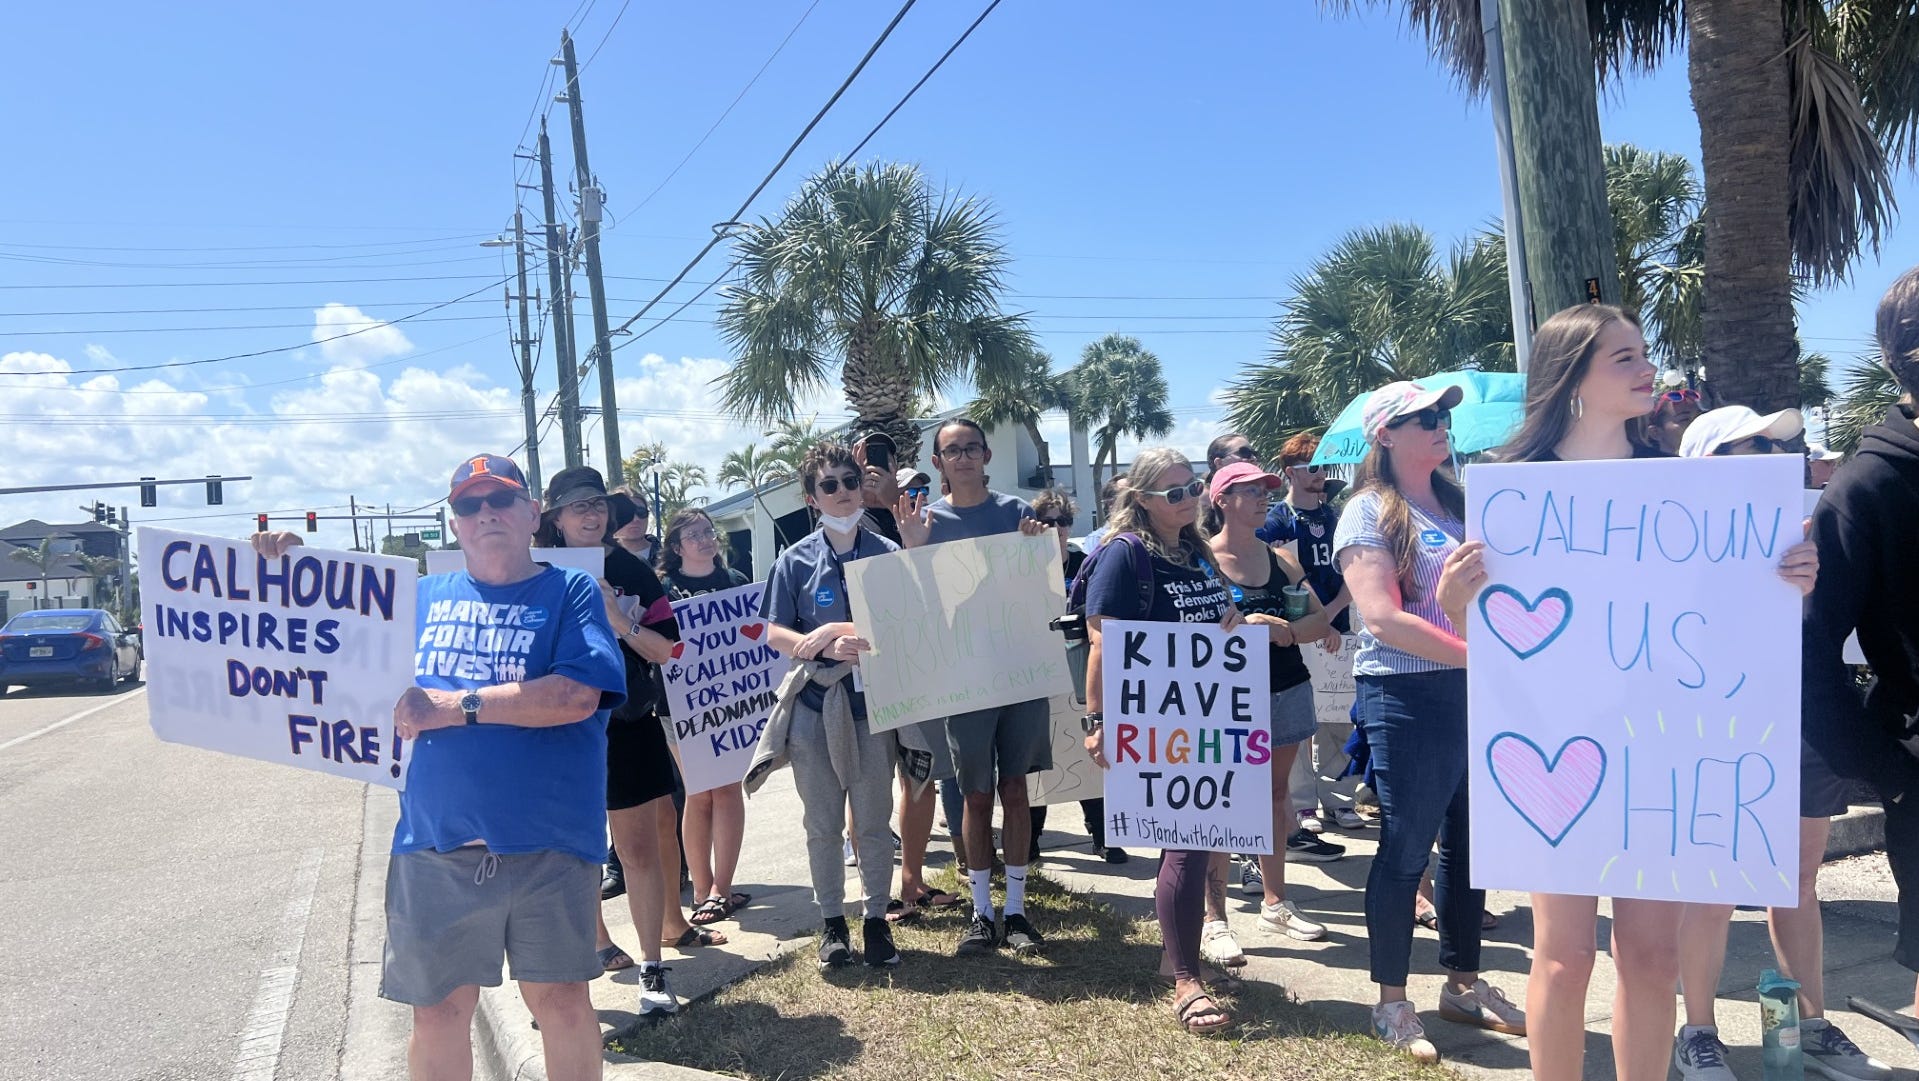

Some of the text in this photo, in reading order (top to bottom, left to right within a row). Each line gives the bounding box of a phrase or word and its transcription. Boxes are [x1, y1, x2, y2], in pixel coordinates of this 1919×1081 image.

[1481, 488, 1781, 563] CALHOUN
[1311, 543, 1331, 566] 13
[162, 540, 396, 621] CALHOUN
[1190, 580, 1204, 592] is
[156, 603, 341, 655] INSPIRES
[673, 592, 760, 631] THANK
[1179, 606, 1216, 624] looks
[419, 625, 476, 650] FOR
[476, 626, 536, 653] OUR
[688, 626, 737, 656] YOU
[1123, 631, 1248, 673] KIDS
[226, 658, 328, 705] DON'T
[415, 650, 493, 681] LIVES
[685, 644, 781, 686] CALHOUN
[993, 662, 1059, 692] CRIME
[686, 667, 774, 711] FOR NOT
[1120, 679, 1253, 722] HAVE
[676, 690, 780, 741] DEADNAMIN
[1116, 723, 1271, 765] RIGHTS
[1138, 770, 1236, 810] TOO!
[1624, 745, 1777, 867] HER
